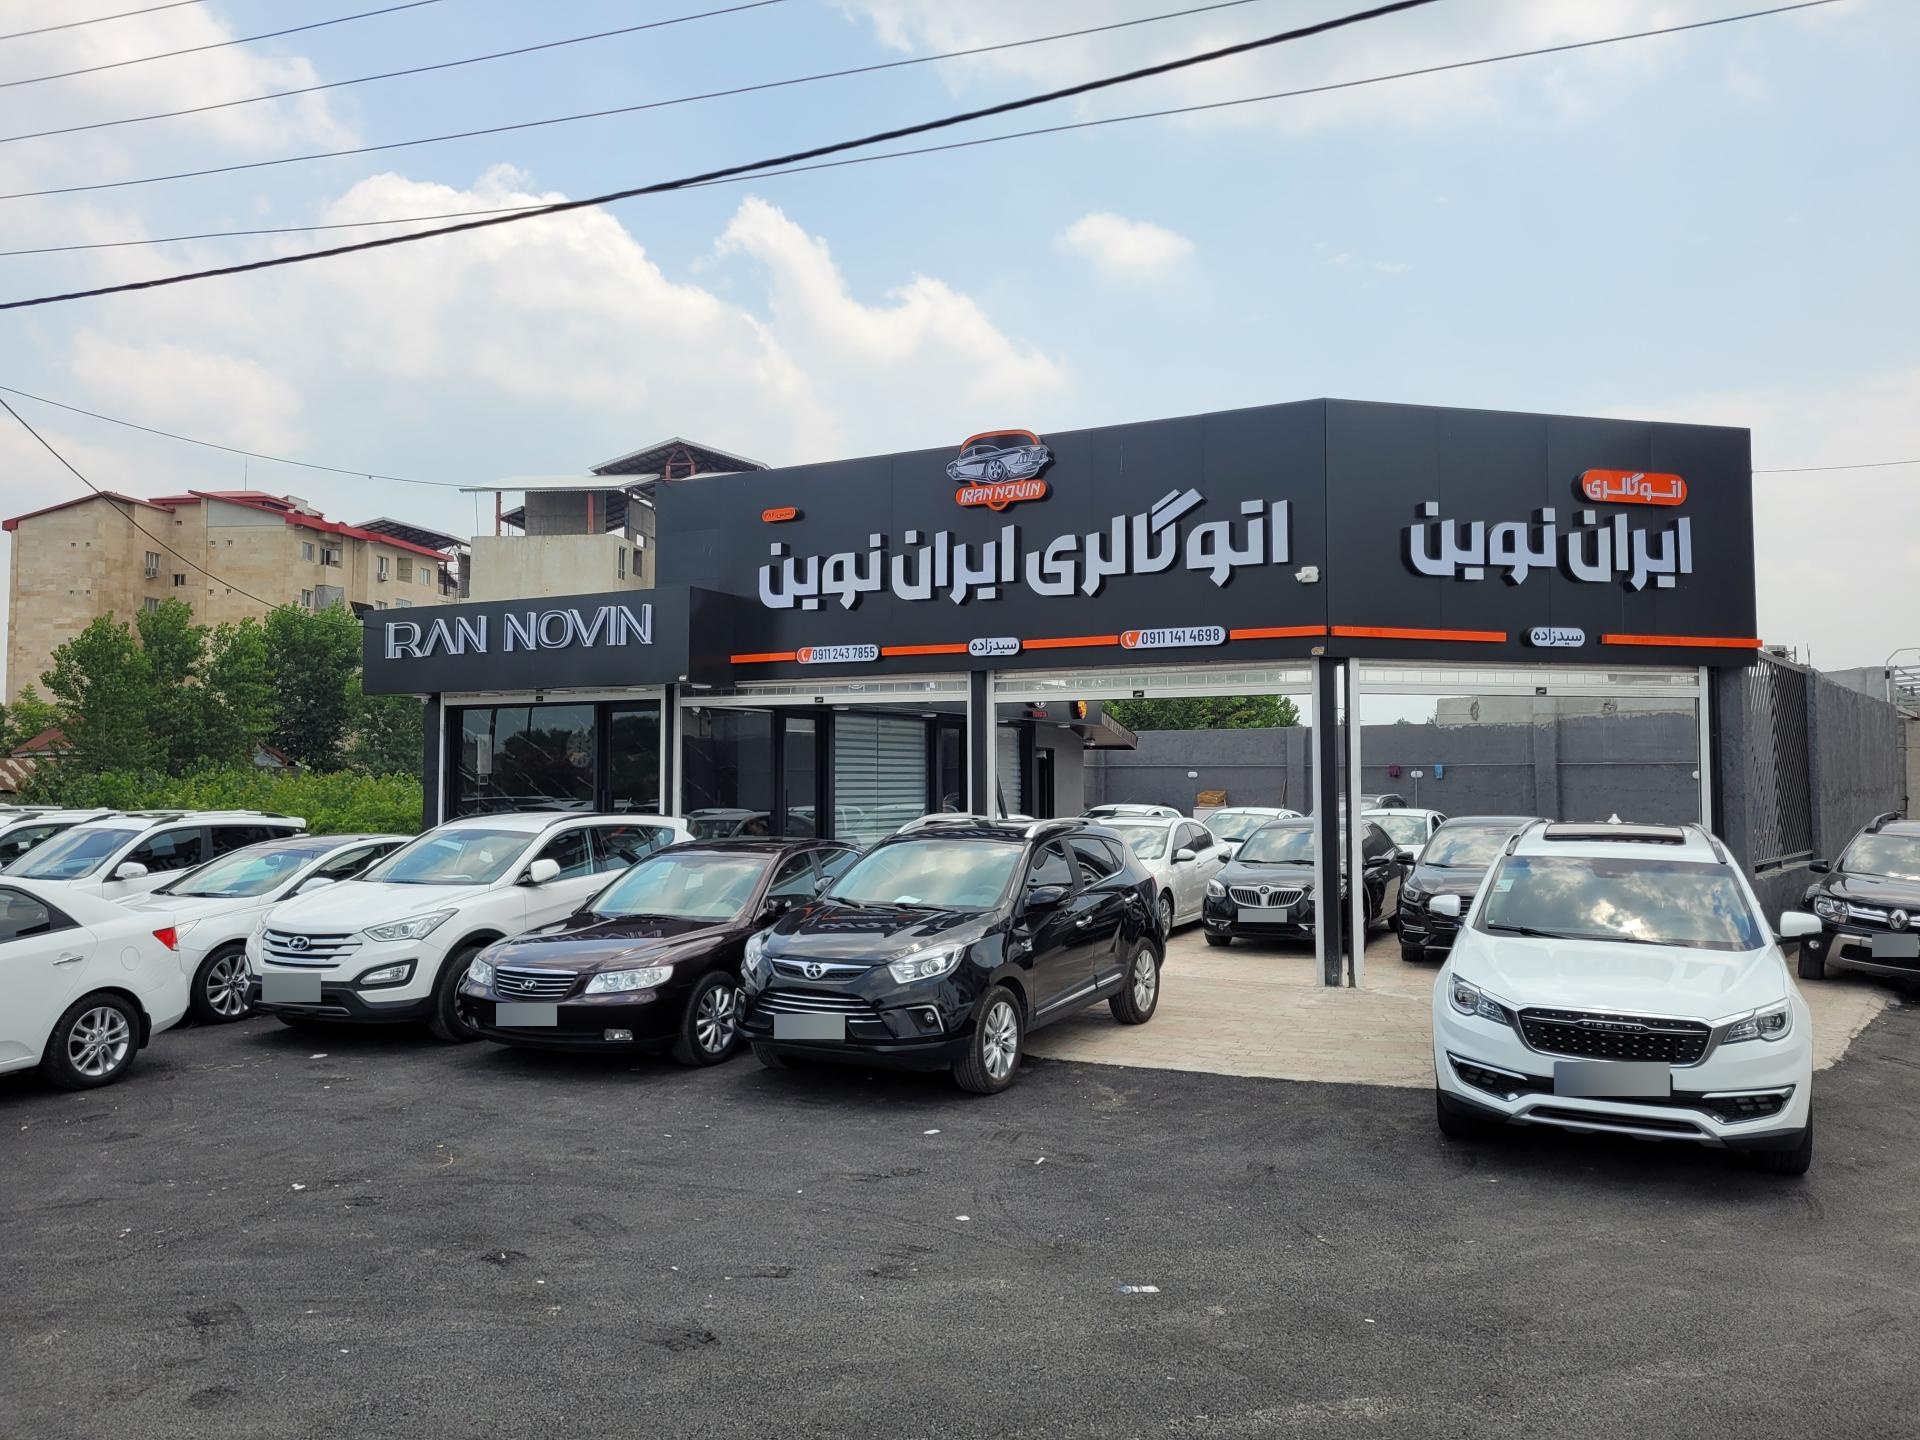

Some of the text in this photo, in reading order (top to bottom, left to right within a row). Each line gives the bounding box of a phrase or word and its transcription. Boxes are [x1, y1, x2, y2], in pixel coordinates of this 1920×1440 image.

[960, 487, 993, 503] IRAN
[1410, 501, 1692, 592] ایران نوین
[758, 533, 881, 610] نوین
[892, 524, 1015, 605] ایران
[384, 603, 653, 659] IRAN NOVIN
[1141, 628, 1220, 645] 0911 141 4698
[1533, 628, 1582, 645] سیدزاده
[812, 646, 875, 660] 0911 243 7855
[971, 638, 1017, 654] سیدزاده
